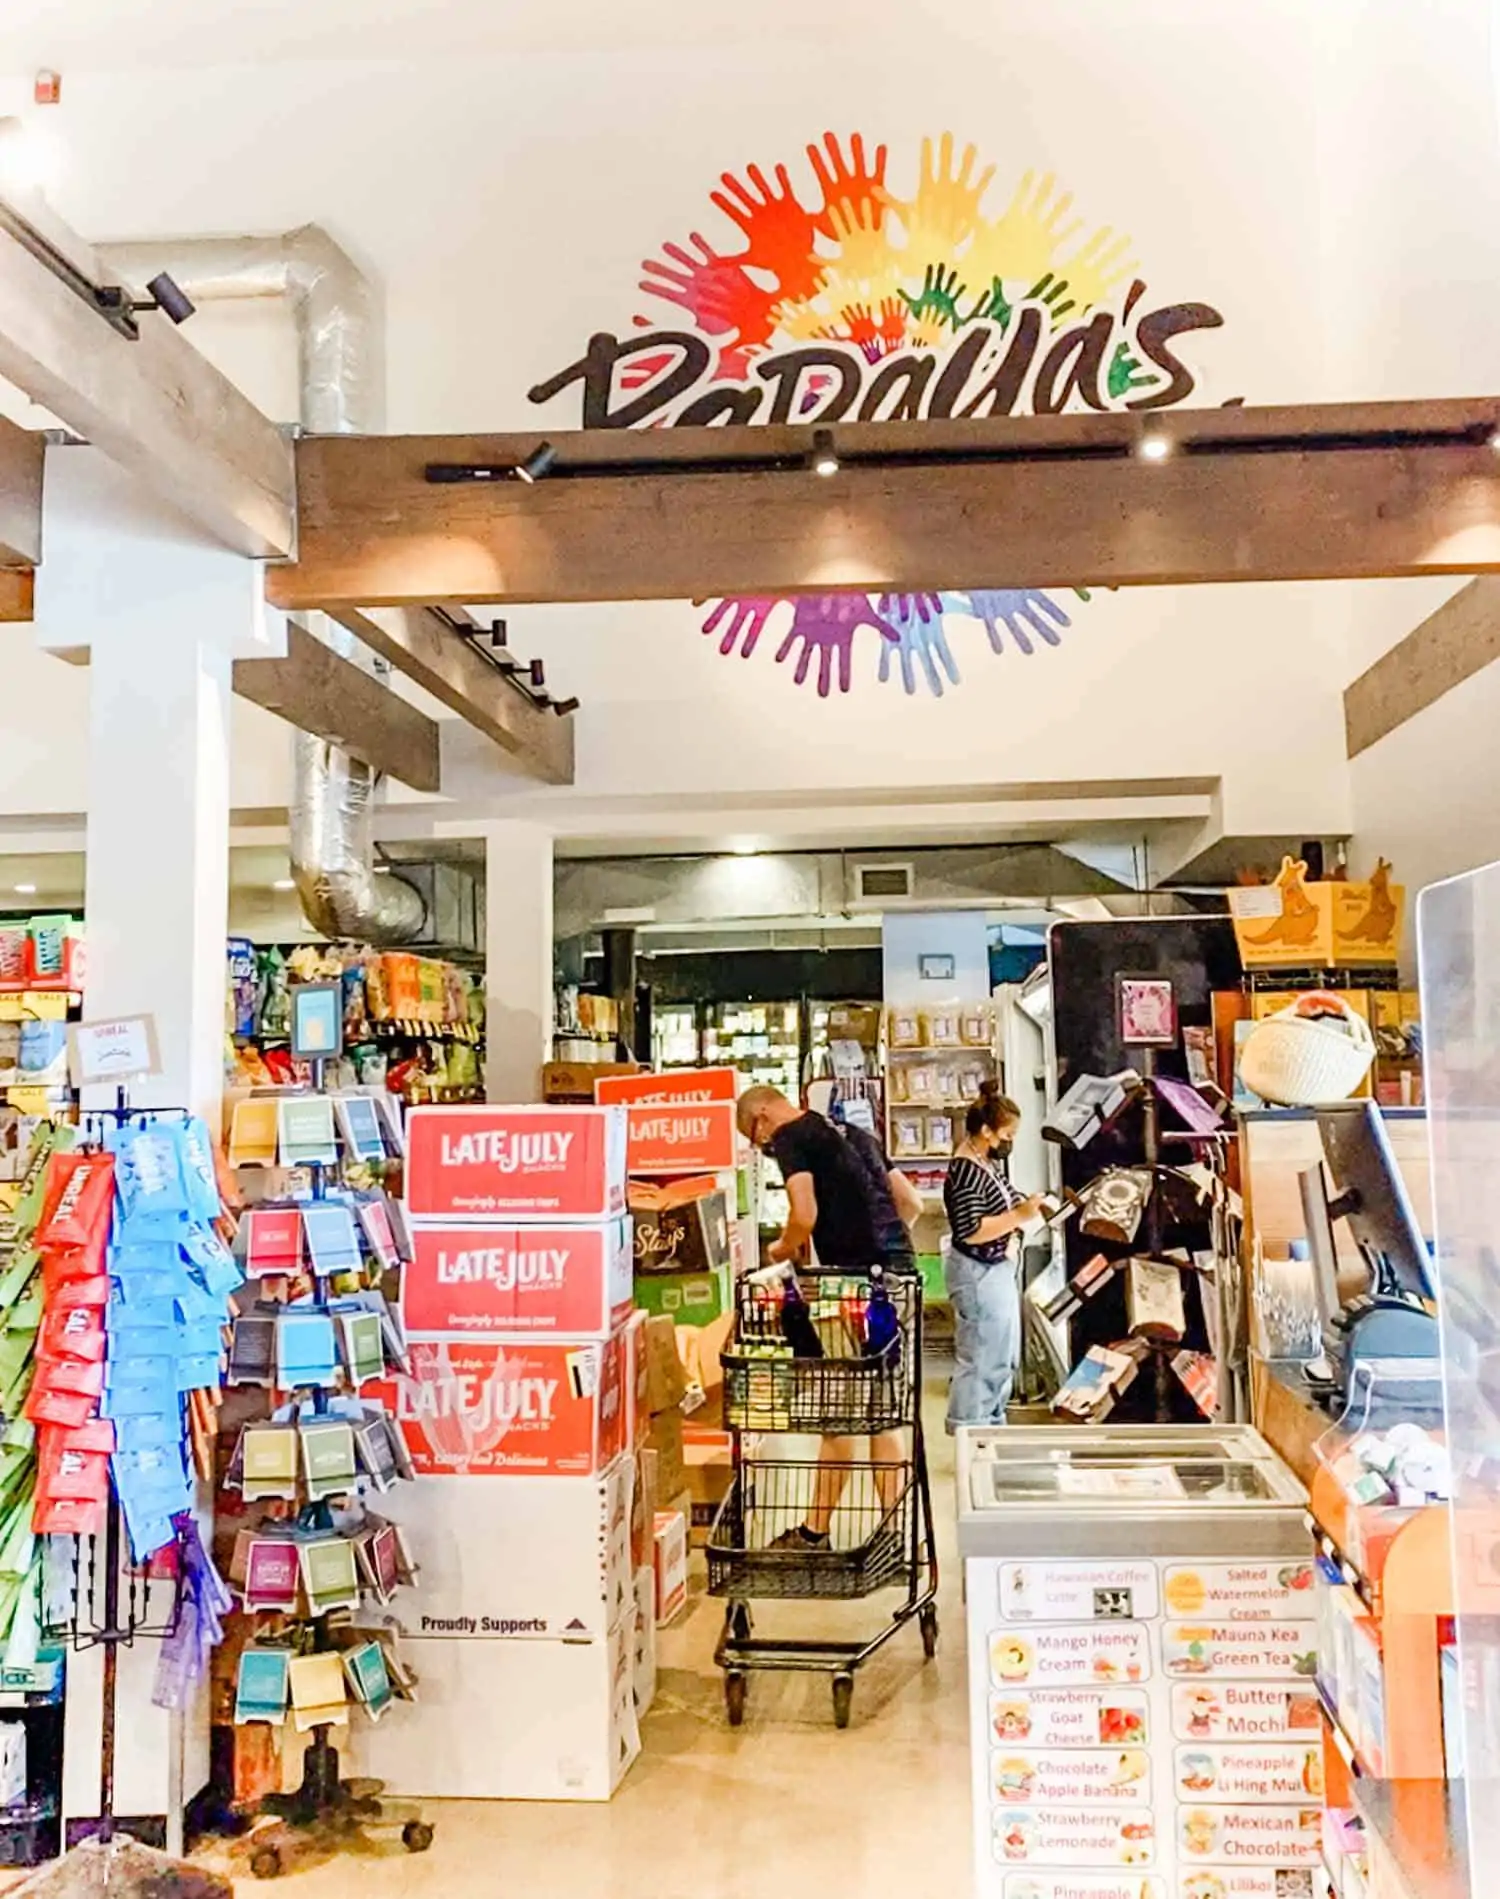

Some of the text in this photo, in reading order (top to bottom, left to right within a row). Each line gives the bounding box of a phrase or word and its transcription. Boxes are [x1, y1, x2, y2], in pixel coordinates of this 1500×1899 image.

[630, 1117, 711, 1145] LATE JULY
[440, 1130, 573, 1173] LATE JULY
[437, 1248, 571, 1291] LATE JULY
[396, 1374, 478, 1421] LATE
[468, 1378, 559, 1432] JULY
[1227, 1568, 1268, 1581] Salted
[1208, 1588, 1290, 1601] Watermelon
[1229, 1608, 1272, 1620] Cream
[421, 1615, 547, 1633] Proudly Supports
[1037, 1632, 1140, 1651] Mango Honey
[1211, 1628, 1300, 1641] Mauna Kea
[1038, 1658, 1087, 1671] Cream
[1212, 1652, 1291, 1665] Green Tea
[1028, 1691, 1105, 1707] Strawberry
[1226, 1689, 1285, 1705] Butter
[1050, 1712, 1084, 1724] Goat
[1226, 1716, 1286, 1733] Mochi
[1045, 1732, 1095, 1745] Cheese
[1037, 1761, 1109, 1775] Chocolate
[1221, 1756, 1296, 1771] Pineapple
[1037, 1783, 1138, 1798] Apple Banana
[1217, 1778, 1230, 1792] Li
[1234, 1778, 1268, 1795] Hing
[1037, 1811, 1121, 1828] Strawberry
[1223, 1815, 1294, 1830] Mexican
[1036, 1836, 1117, 1848] Lemonade
[1223, 1840, 1308, 1856] Chocolate
[1053, 1885, 1132, 1899] Pineapple
